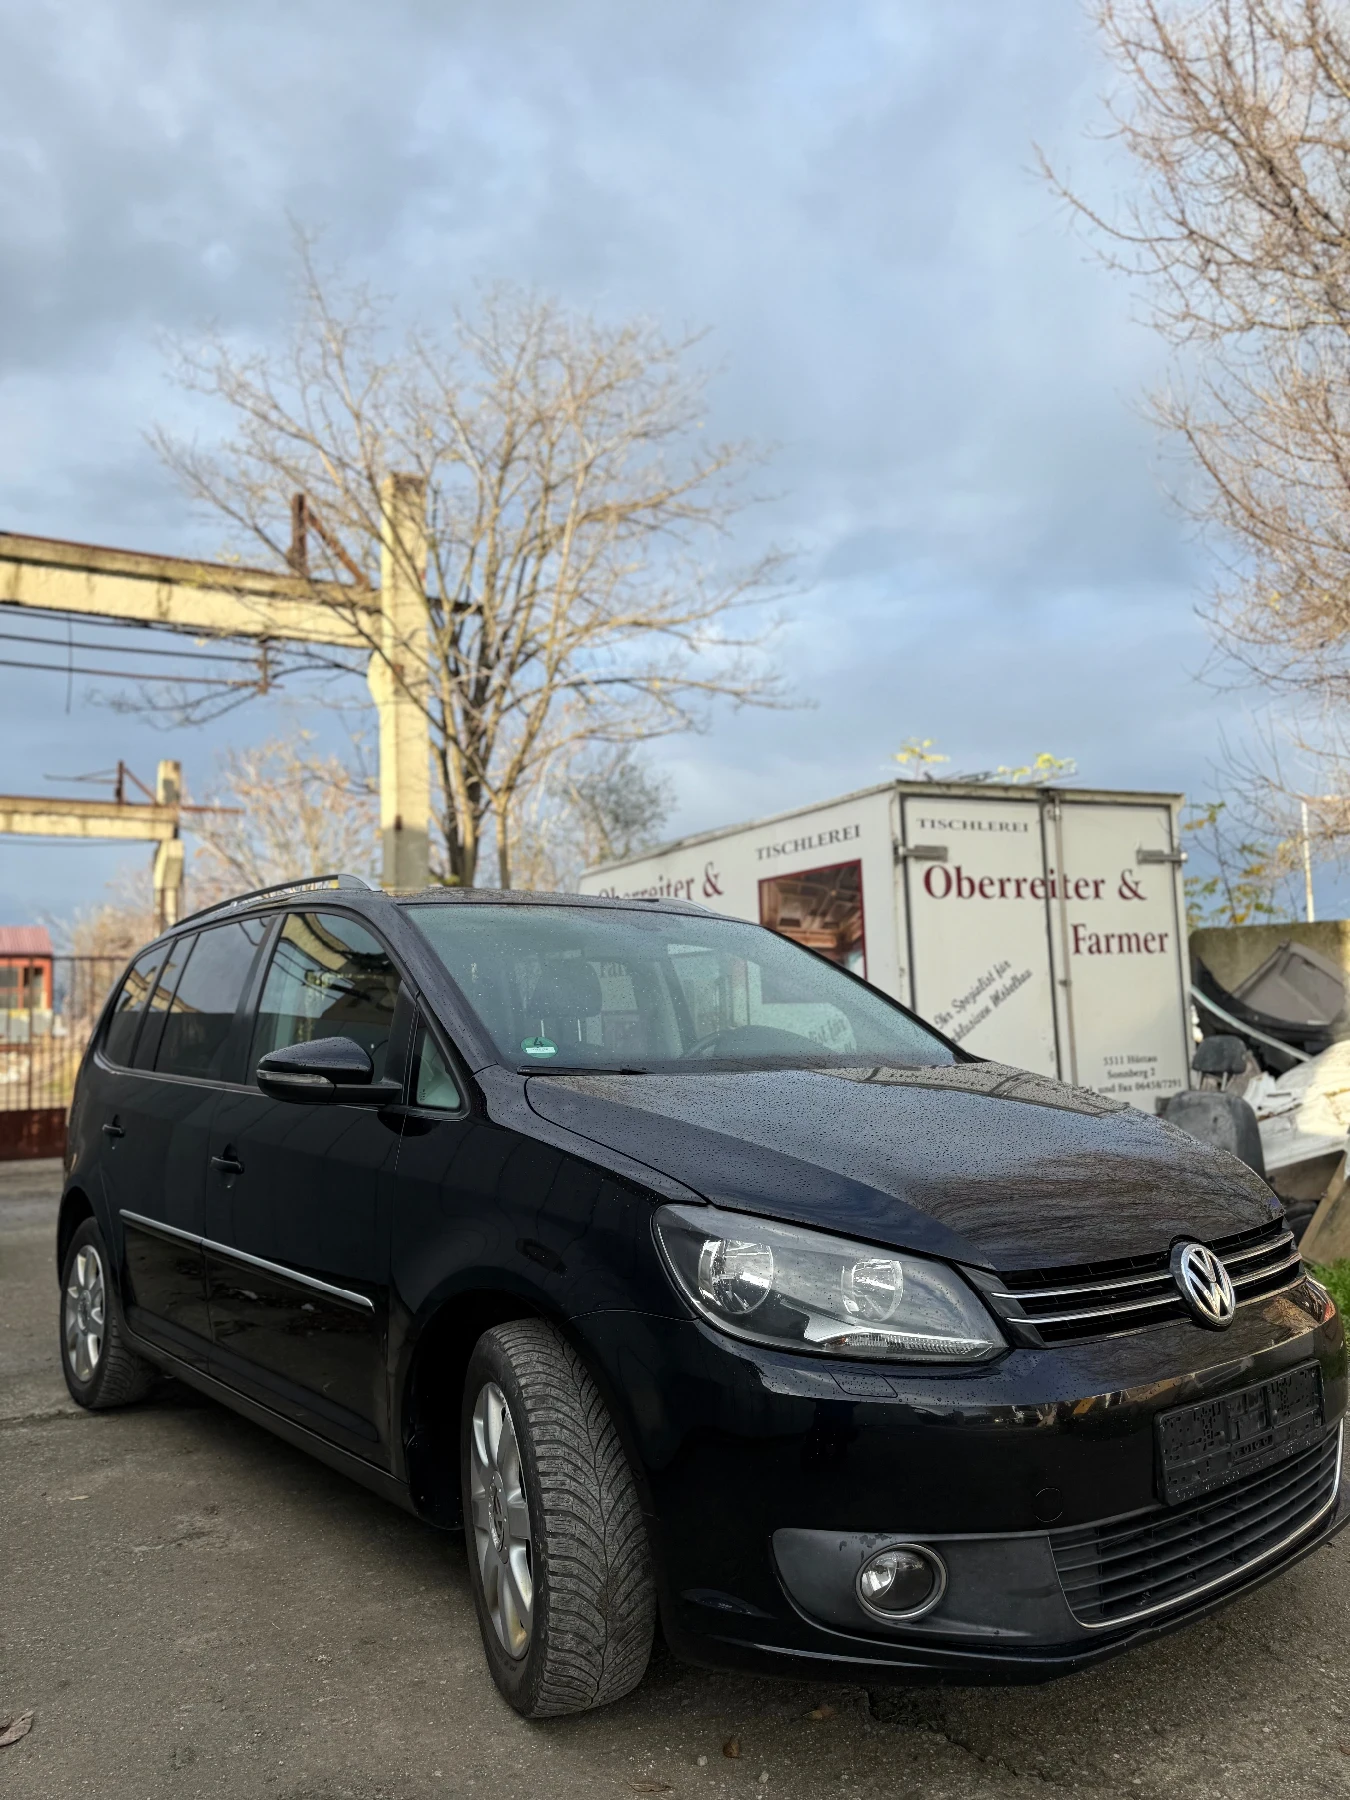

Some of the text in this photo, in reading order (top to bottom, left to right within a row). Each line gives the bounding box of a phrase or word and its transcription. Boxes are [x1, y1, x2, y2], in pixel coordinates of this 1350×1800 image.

[916, 817, 1030, 833] TISCHLEREI
[755, 824, 861, 860] TISCHLEREI
[702, 861, 724, 898] &
[923, 864, 1148, 901] Oberreiter &
[1070, 922, 1169, 955] Farmer
[1107, 1068, 1149, 1080] Sonnberg
[1117, 1082, 1133, 1093] Fax
